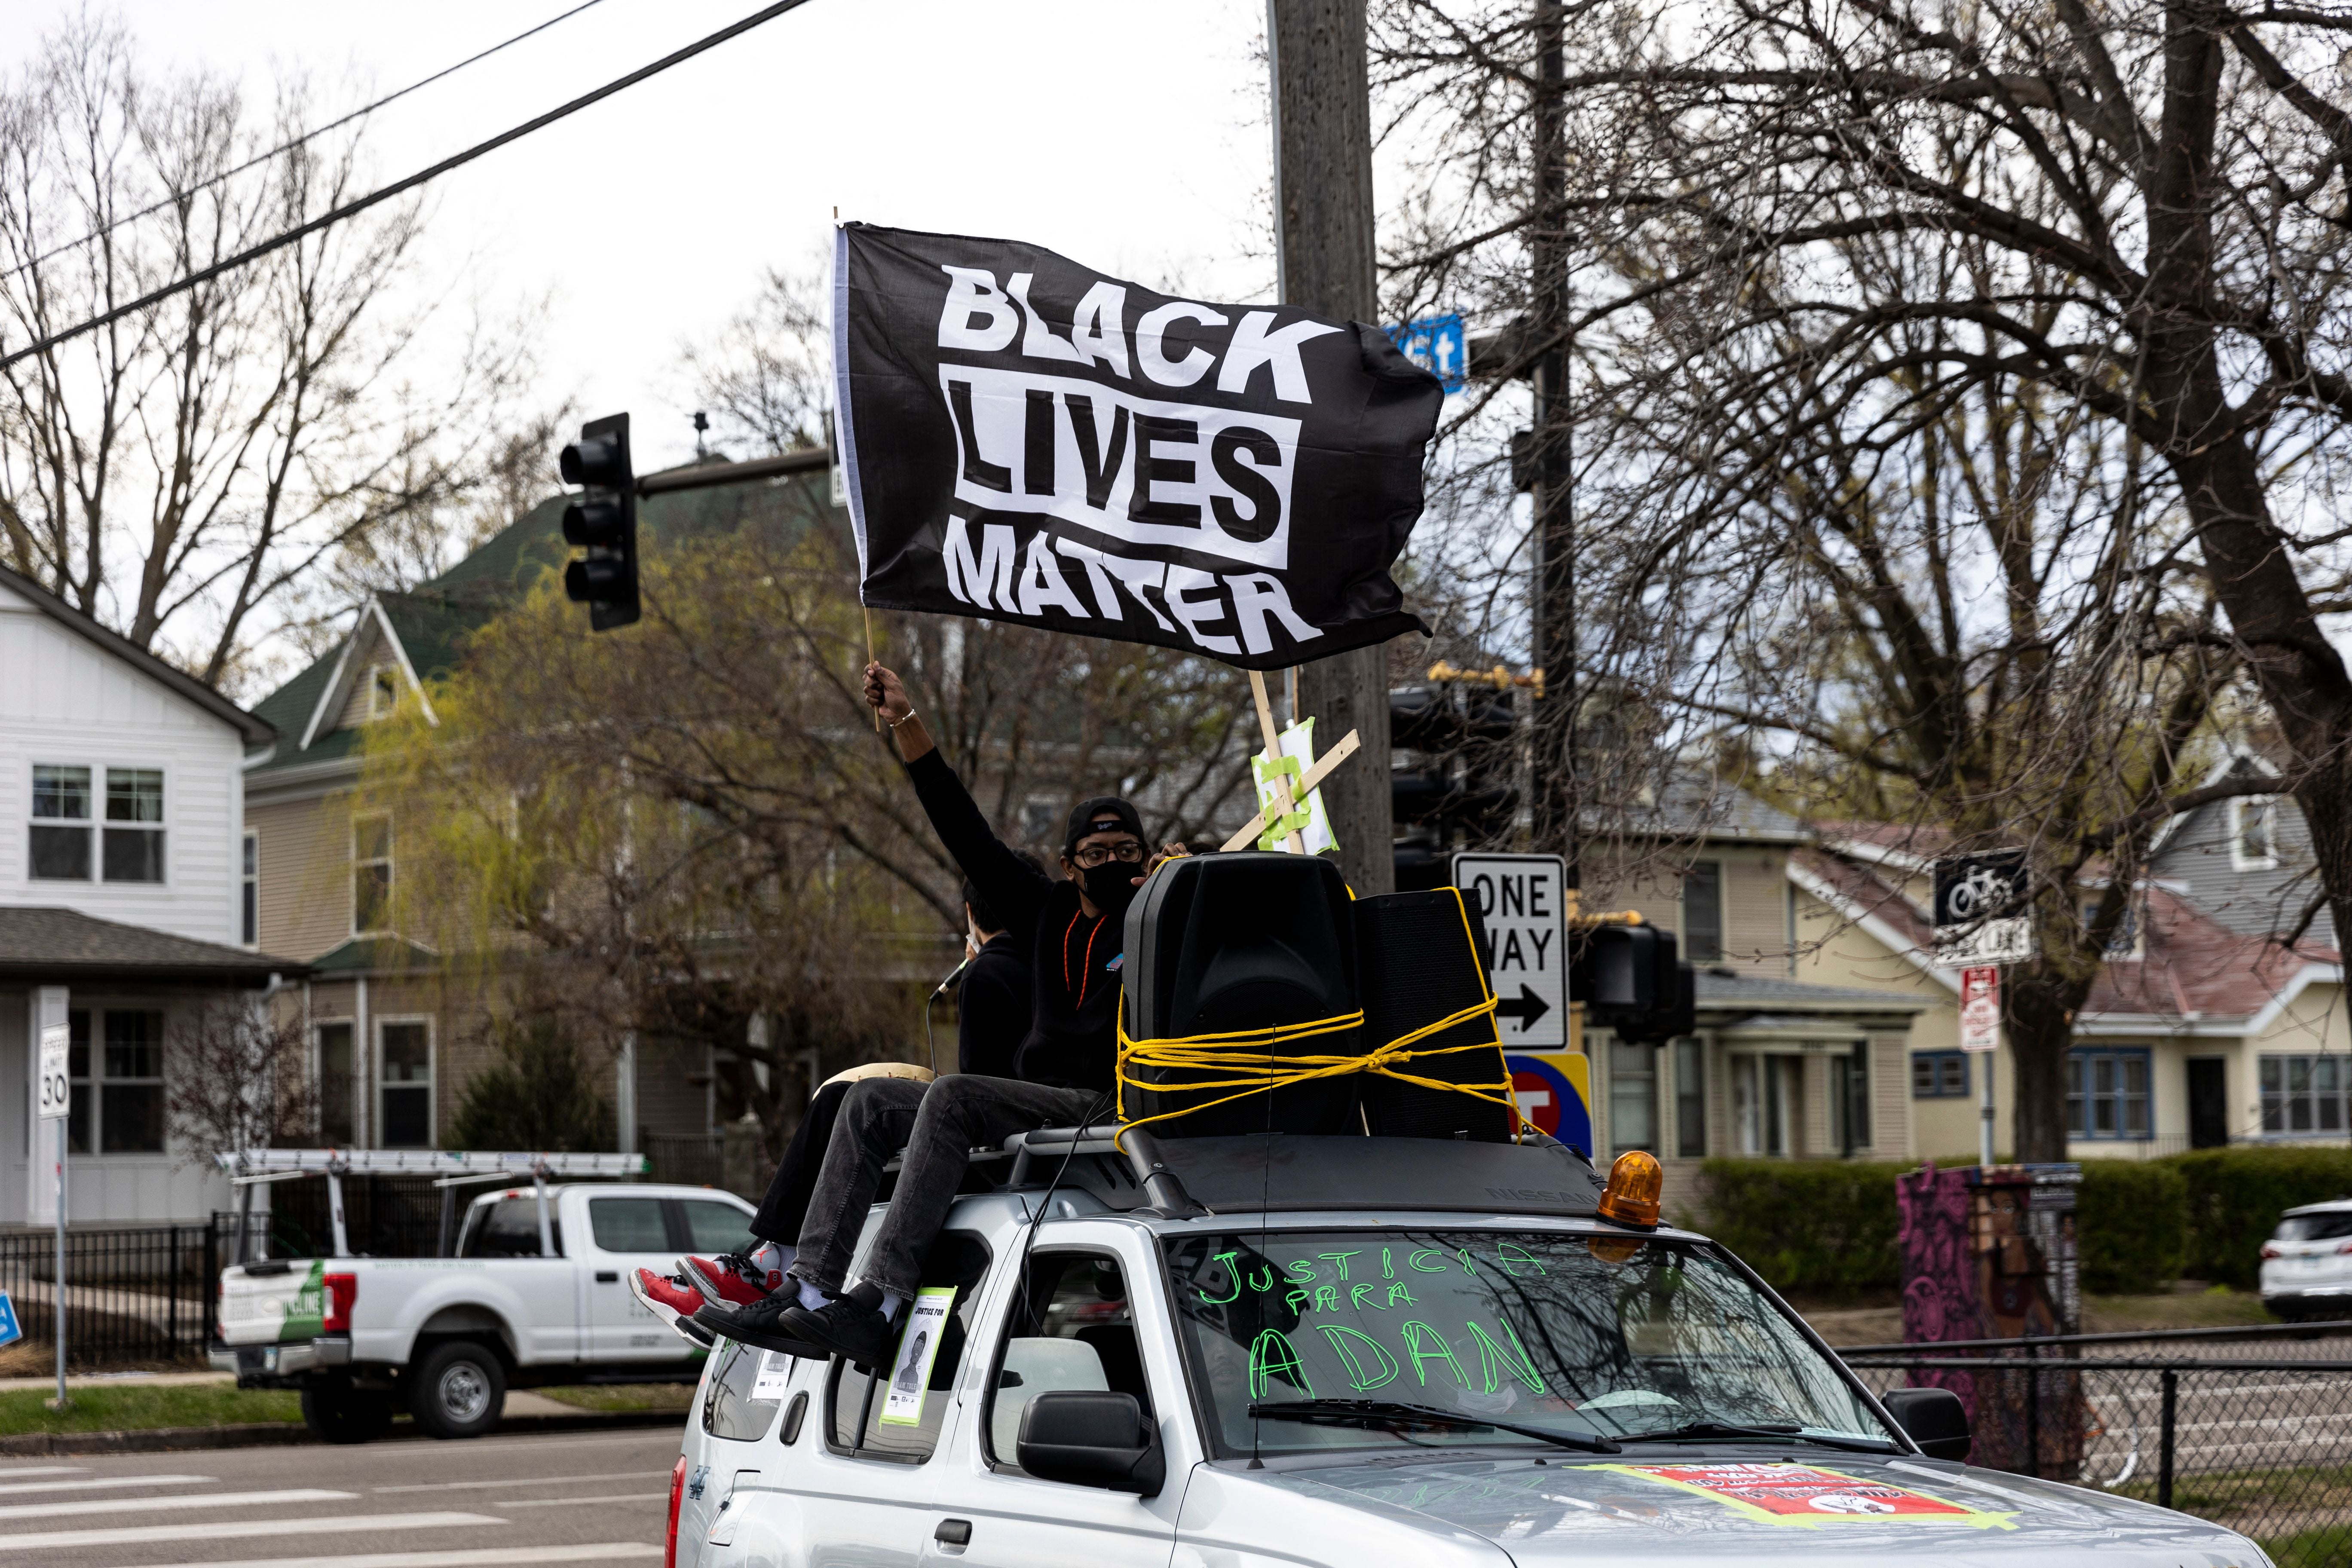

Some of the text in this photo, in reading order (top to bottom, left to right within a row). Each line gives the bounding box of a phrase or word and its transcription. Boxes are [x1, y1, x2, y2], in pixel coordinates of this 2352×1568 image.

[938, 264, 1344, 404] BLACK
[947, 379, 1283, 543] LIVES
[943, 514, 1324, 655] MATTER
[1473, 873, 1550, 917] ONE
[43, 1075, 66, 1105] 30
[1484, 1187, 1599, 1205] NISSAN
[1200, 1243, 1546, 1304] JUSTICIA
[915, 1307, 934, 1316] JUSTICE
[1286, 1281, 1418, 1316] PARA
[1250, 1317, 1545, 1400] ADAN
[894, 1381, 906, 1389] ADAM
